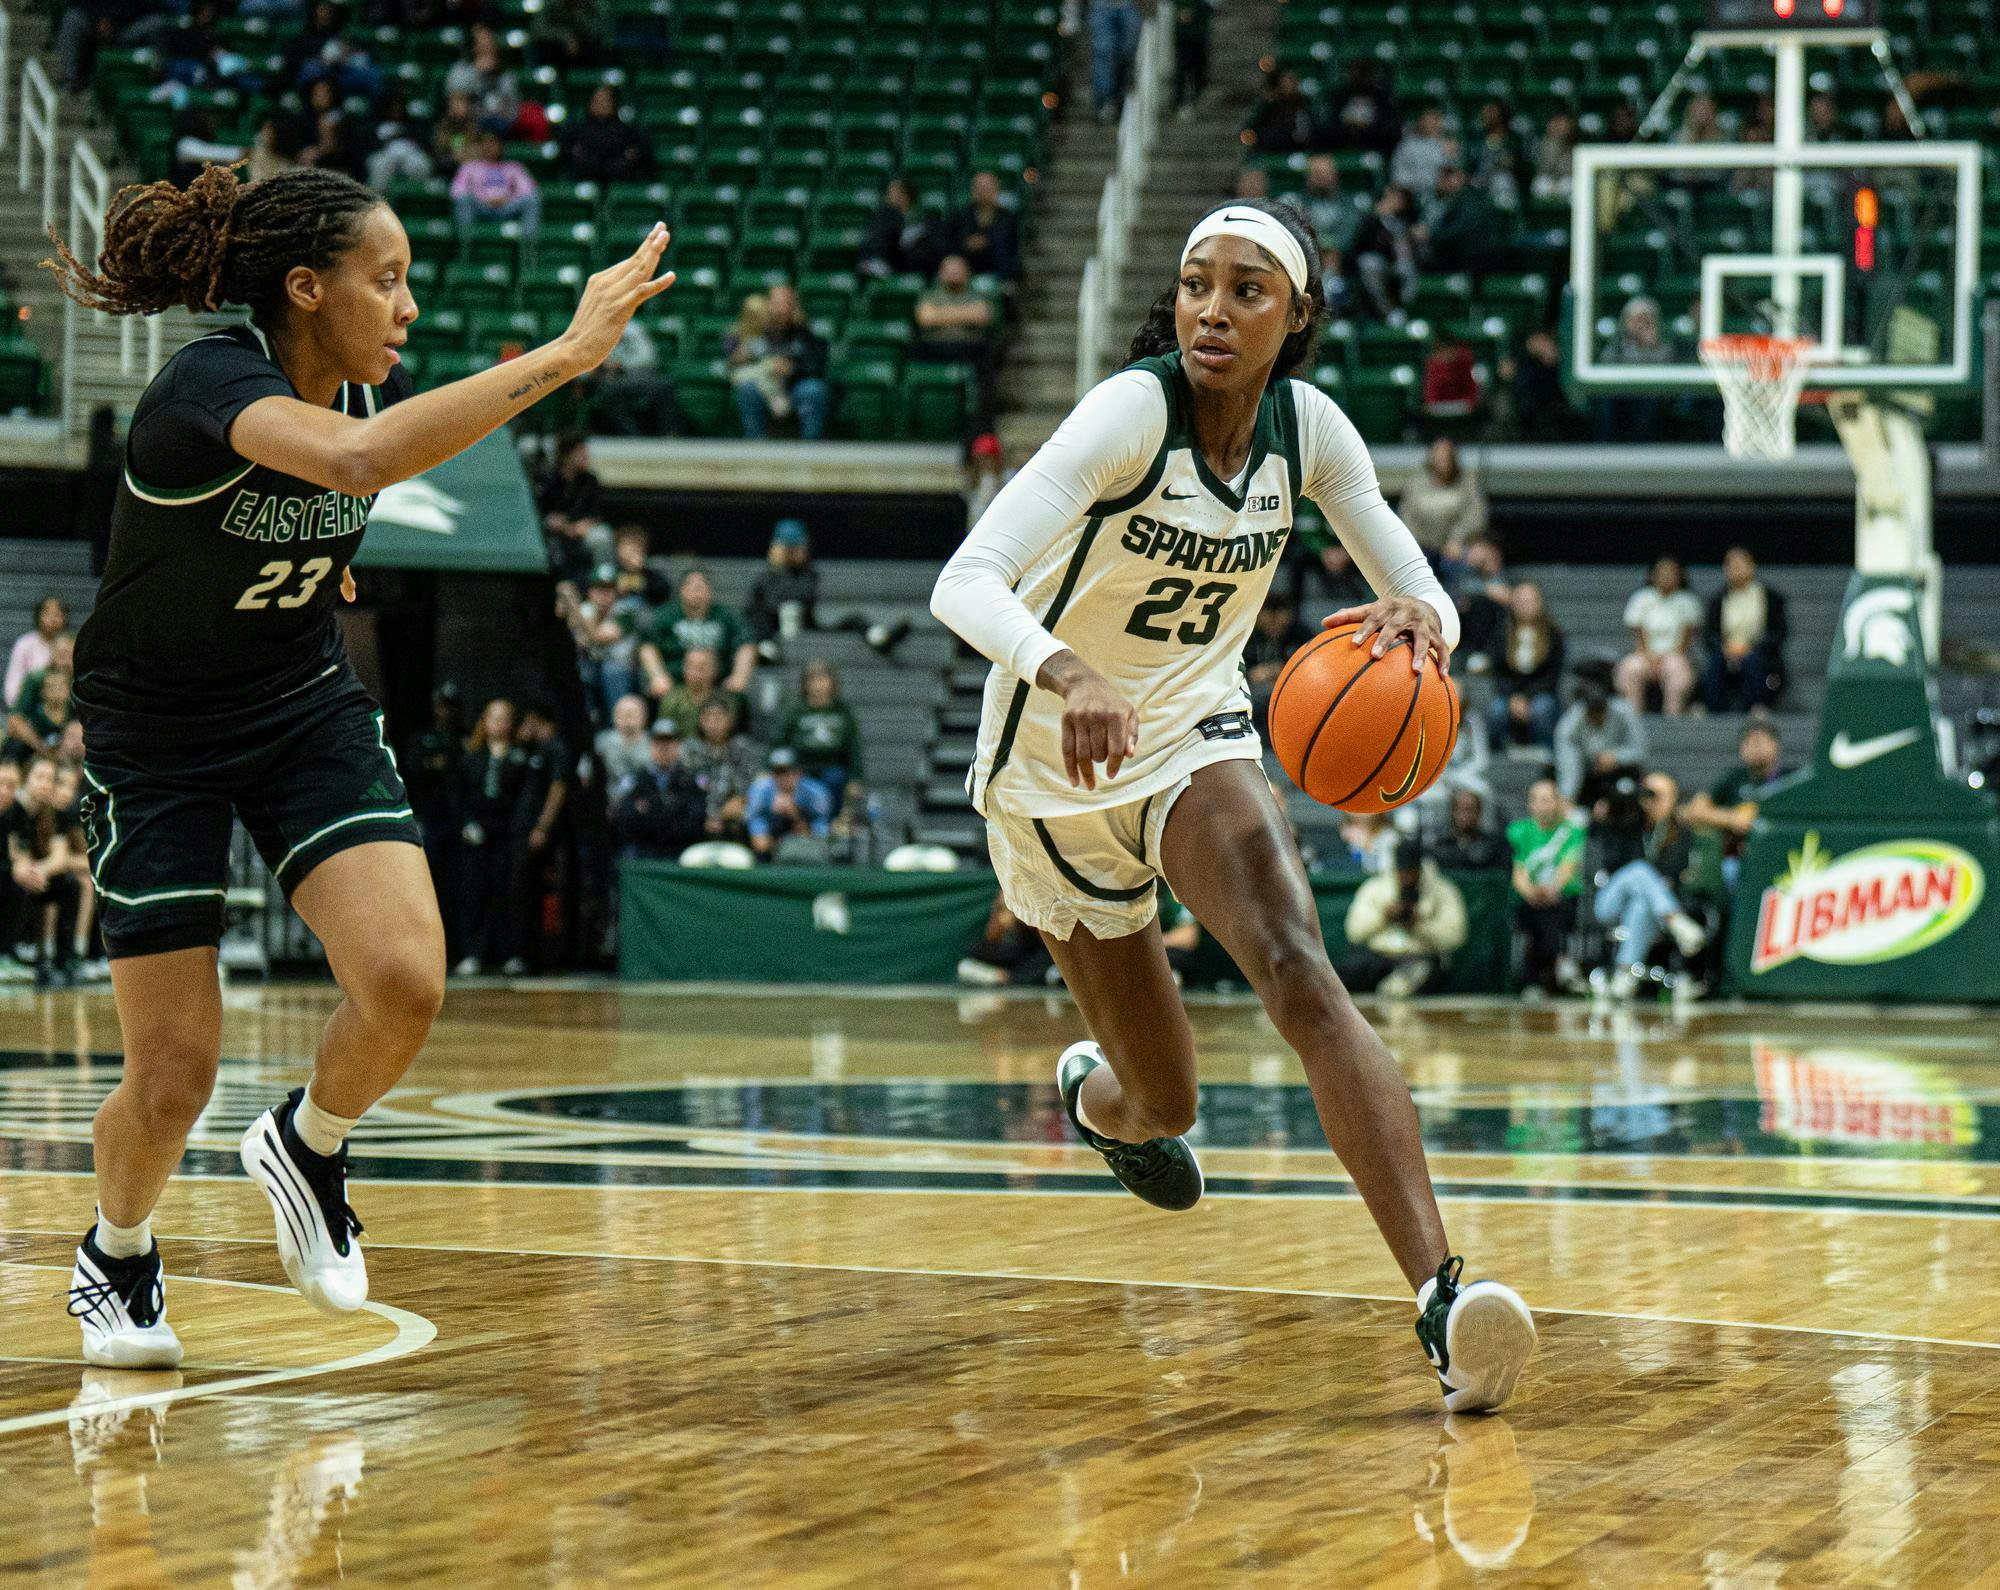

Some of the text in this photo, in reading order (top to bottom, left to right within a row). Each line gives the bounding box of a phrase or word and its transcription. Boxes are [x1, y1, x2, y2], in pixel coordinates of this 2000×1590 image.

[221, 489, 373, 543] EASTERN
[1120, 514, 1290, 574] SPARTANS
[234, 556, 334, 609] 23
[1124, 577, 1238, 646] 23
[1759, 864, 1956, 958] LIBMAN
